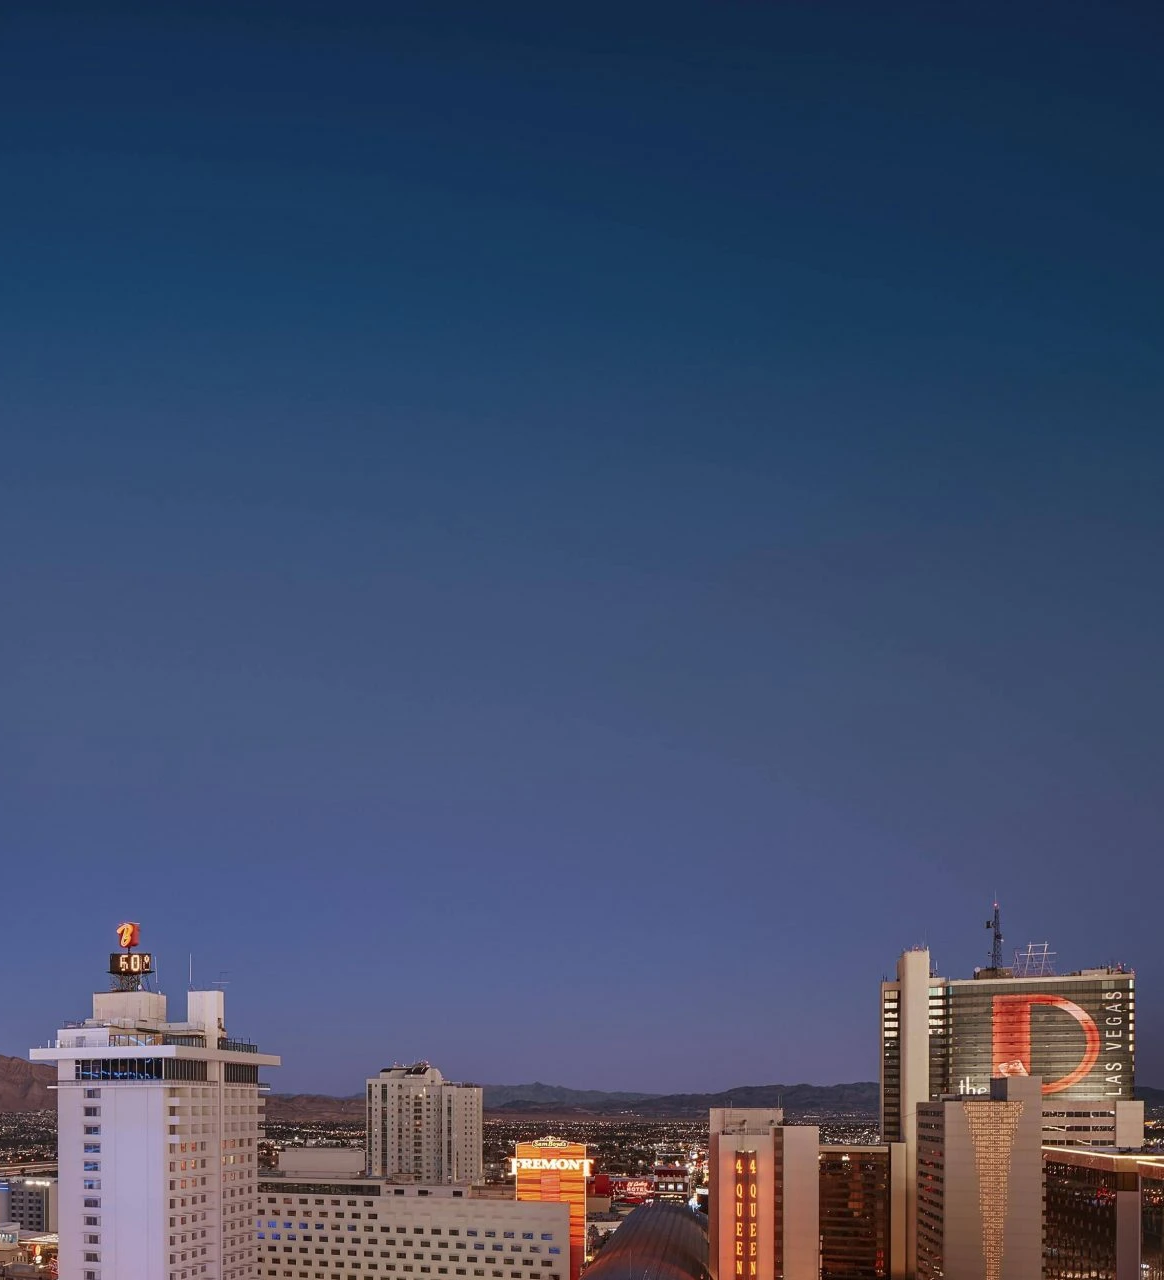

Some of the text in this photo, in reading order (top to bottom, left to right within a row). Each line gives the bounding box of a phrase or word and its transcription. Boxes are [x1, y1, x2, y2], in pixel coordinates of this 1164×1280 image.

[1105, 991, 1123, 1096] LAS VEGAS
[508, 1158, 595, 1177] FREMONT
[735, 1159, 743, 1174] 4
[749, 1159, 756, 1174] 4
